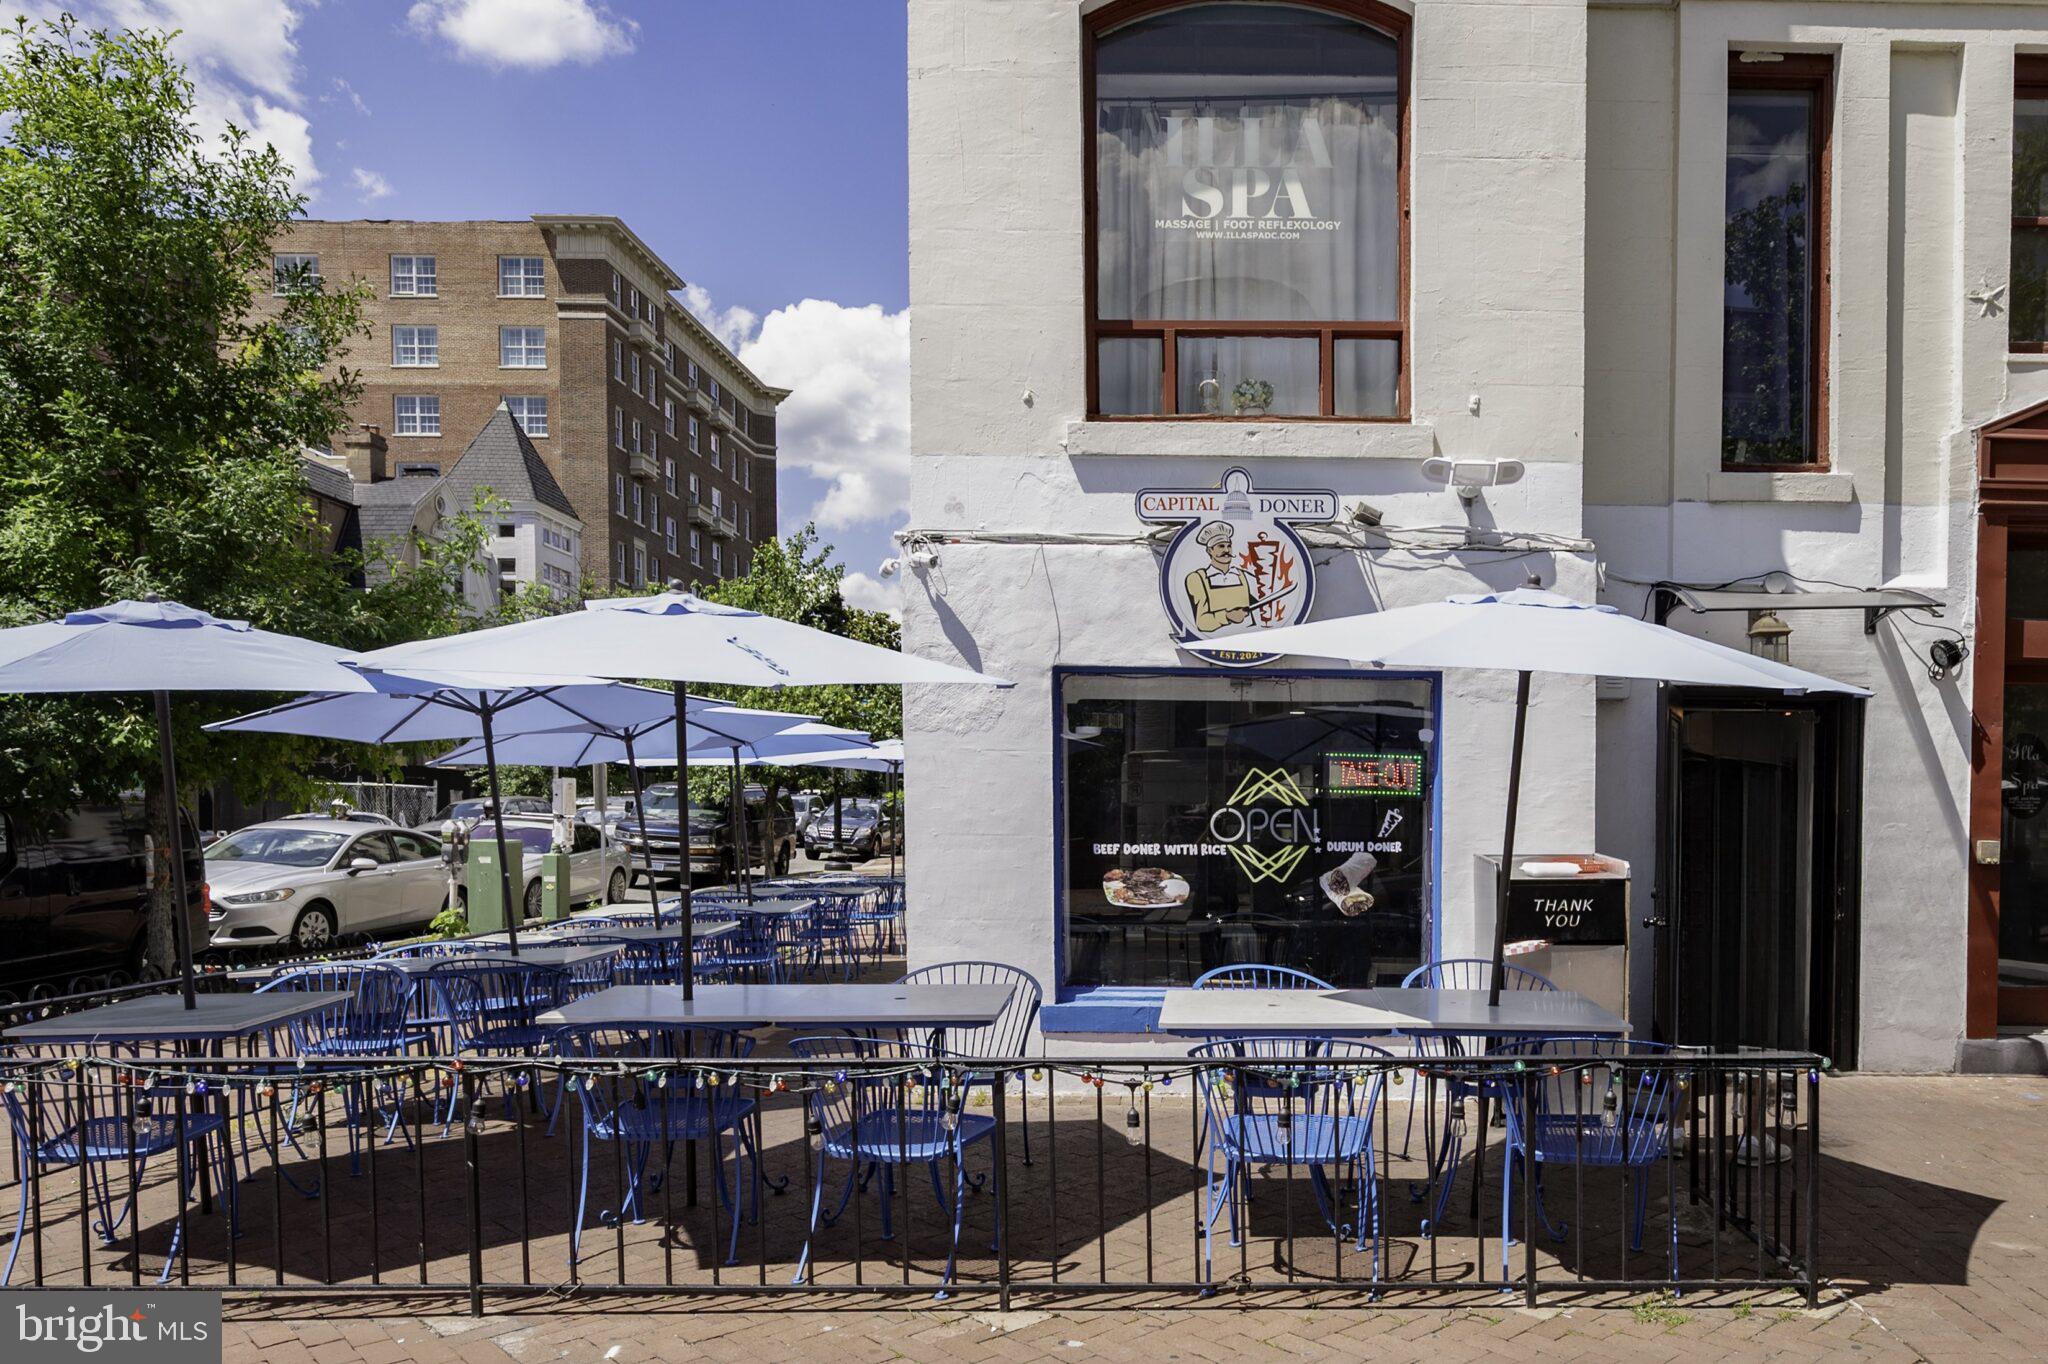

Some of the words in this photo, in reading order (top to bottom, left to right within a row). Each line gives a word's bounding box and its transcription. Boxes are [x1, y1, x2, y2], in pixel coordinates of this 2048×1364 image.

[1160, 117, 1334, 168] ILLA
[1182, 168, 1317, 219] SPA
[1155, 219, 1211, 230] MASSAGE
[1223, 220, 1255, 230] FOOT
[1258, 220, 1342, 231] REFLEXOLOGY
[1196, 231, 1300, 240] WWW.ILLASPADC.COM
[1144, 497, 1220, 511] CAPITAL
[1260, 499, 1325, 513] DONER
[1210, 807, 1318, 843] OPEN
[1093, 843, 1120, 855] BEEF
[1123, 843, 1161, 856] DONER
[1164, 844, 1198, 856] WITH
[1200, 843, 1227, 856] RICE
[1326, 841, 1364, 852] DURUM
[1367, 841, 1402, 853] DONER
[1534, 899, 1594, 912] THANK
[1545, 914, 1581, 928] YOU
